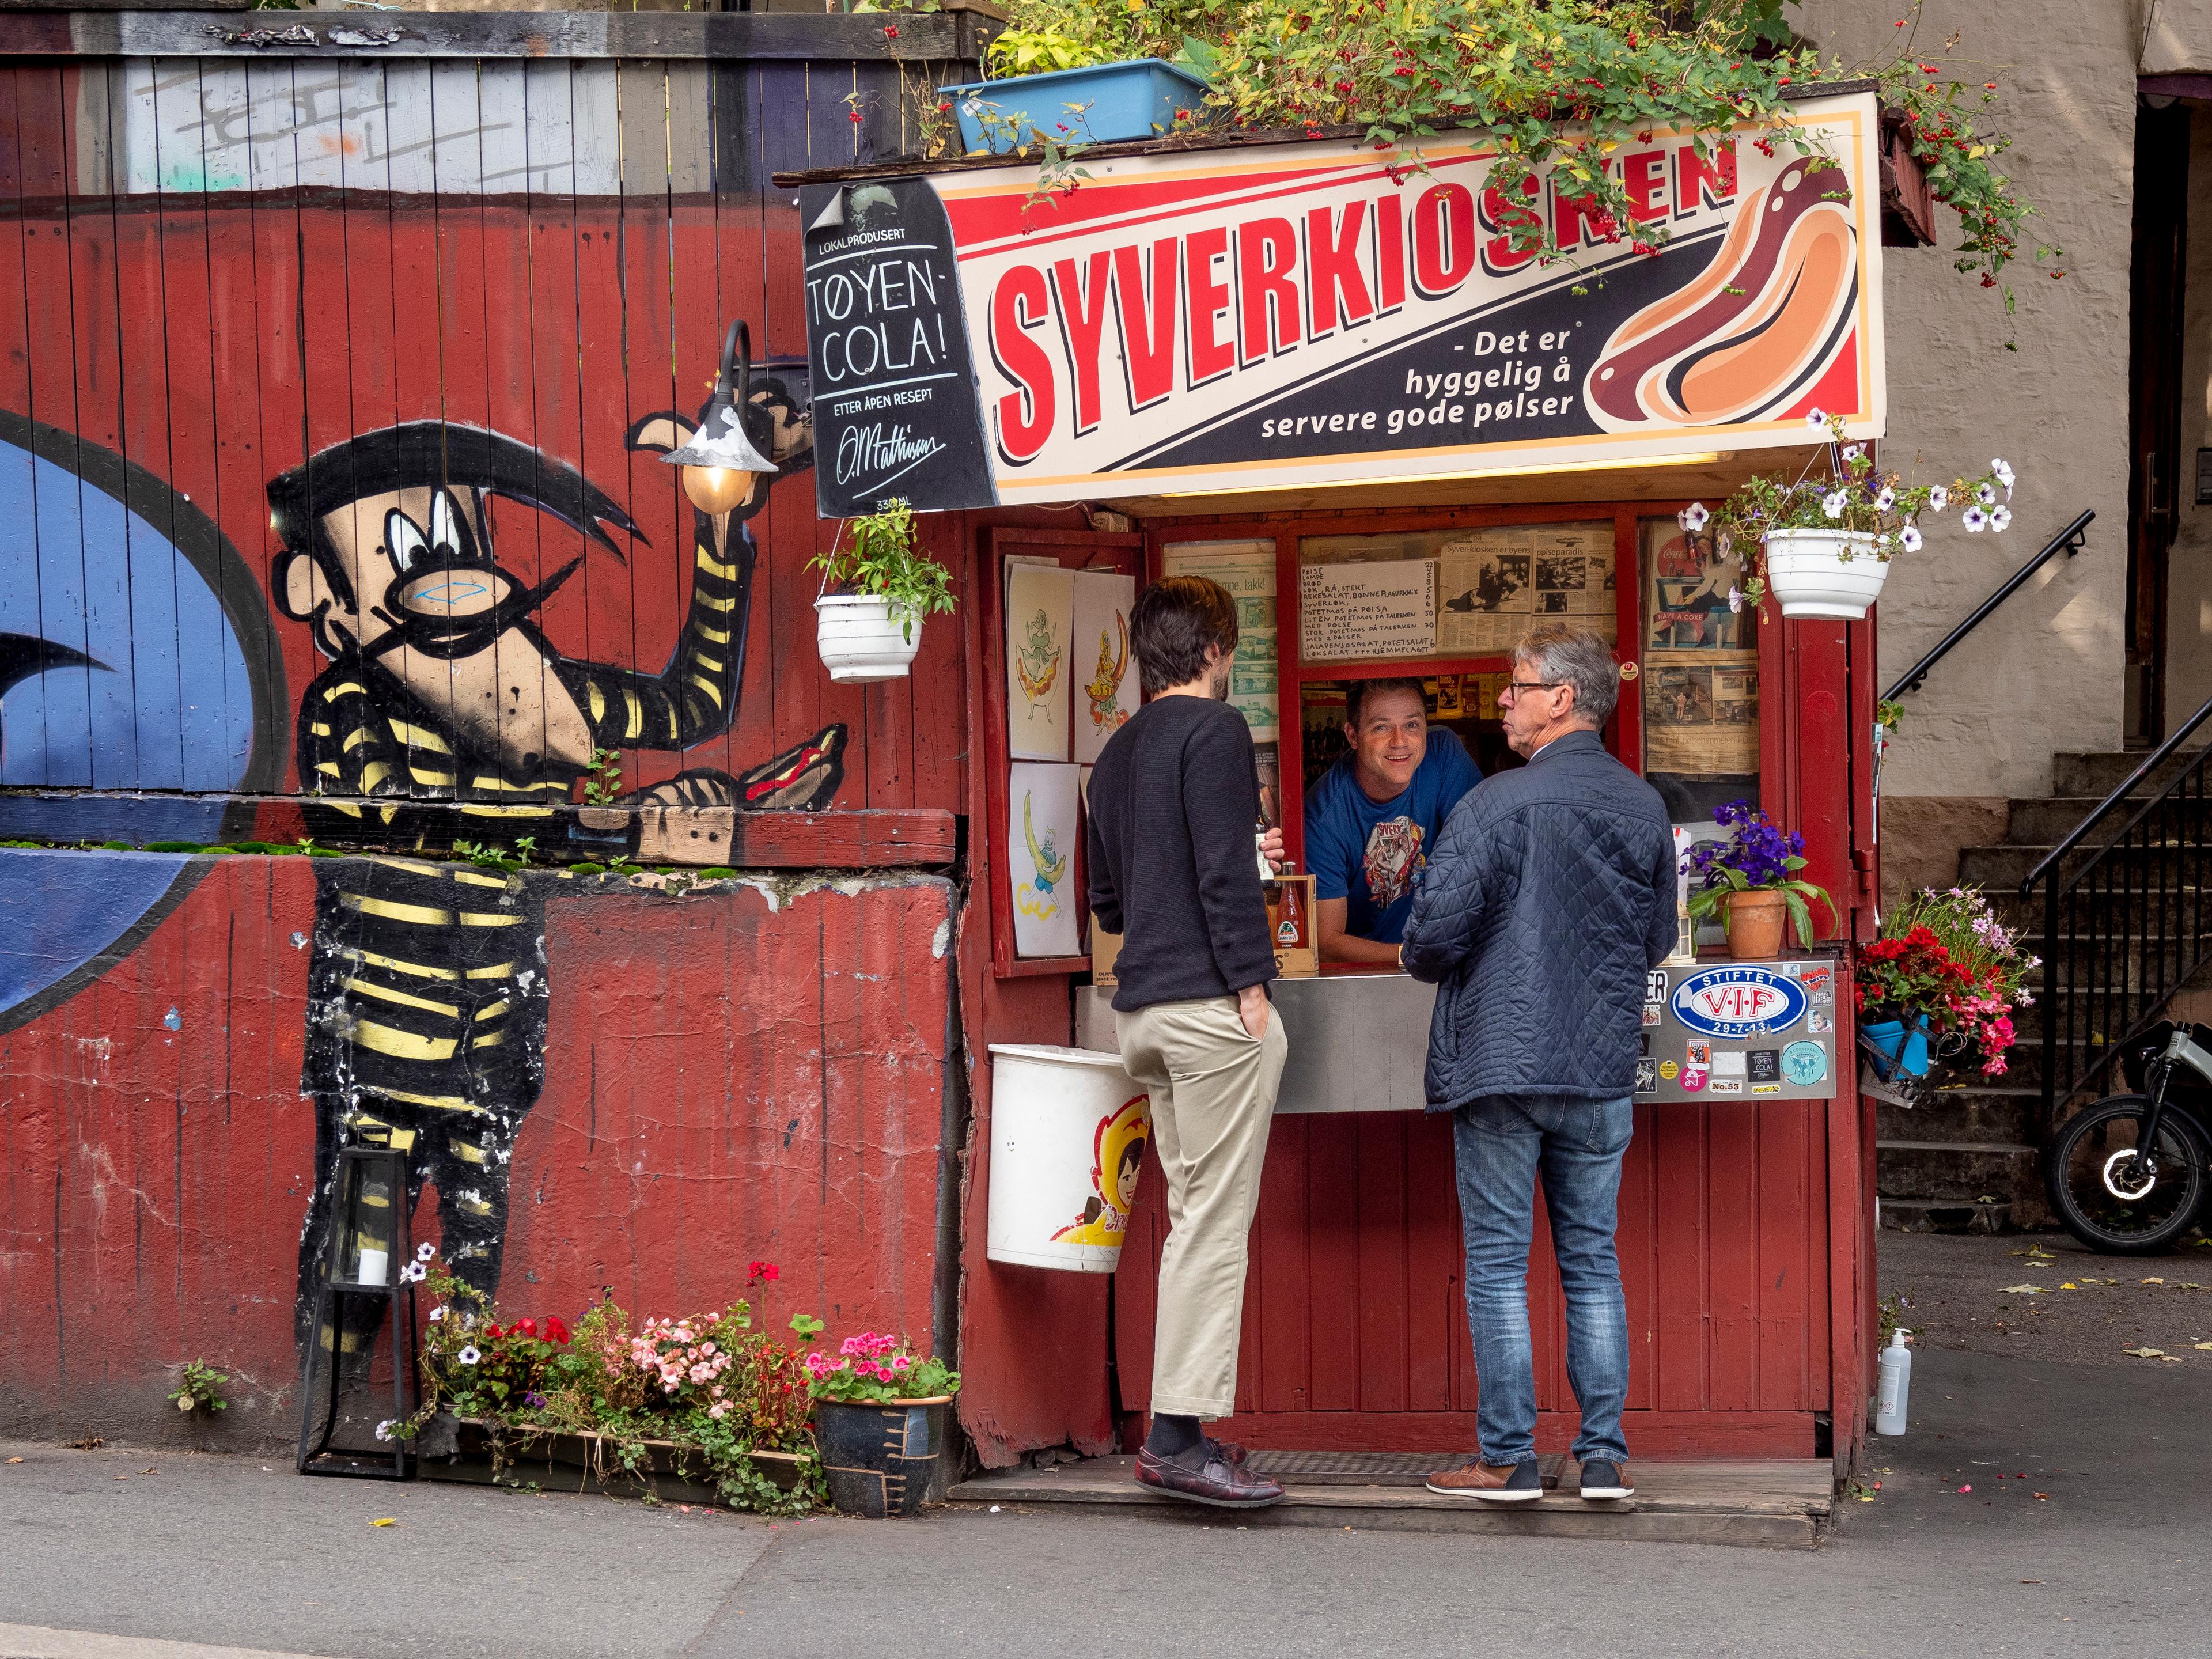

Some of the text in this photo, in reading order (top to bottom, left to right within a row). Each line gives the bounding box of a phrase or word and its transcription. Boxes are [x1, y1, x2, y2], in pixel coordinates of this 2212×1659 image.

[819, 228, 905, 255] LOKALPRODUSERT
[806, 259, 945, 325] TØYEN-
[988, 138, 1738, 467] SYVERKIOSKEN
[823, 313, 947, 381] COLA!
[1475, 330, 1535, 356] Det
[1539, 329, 1571, 351] er
[1405, 356, 1571, 400] hyggelig å
[834, 388, 933, 416] ETTER ÅPEN RESEPT
[1262, 393, 1574, 438] servere gode pølser
[1447, 544, 1498, 555] Syver-kiosken
[1509, 546, 1531, 555] byens
[1536, 548, 1584, 556] pølseparadis
[1244, 577, 1266, 590] takk!
[1702, 970, 1777, 987] STIFTET
[1713, 1021, 1766, 1033] 29-7-13
